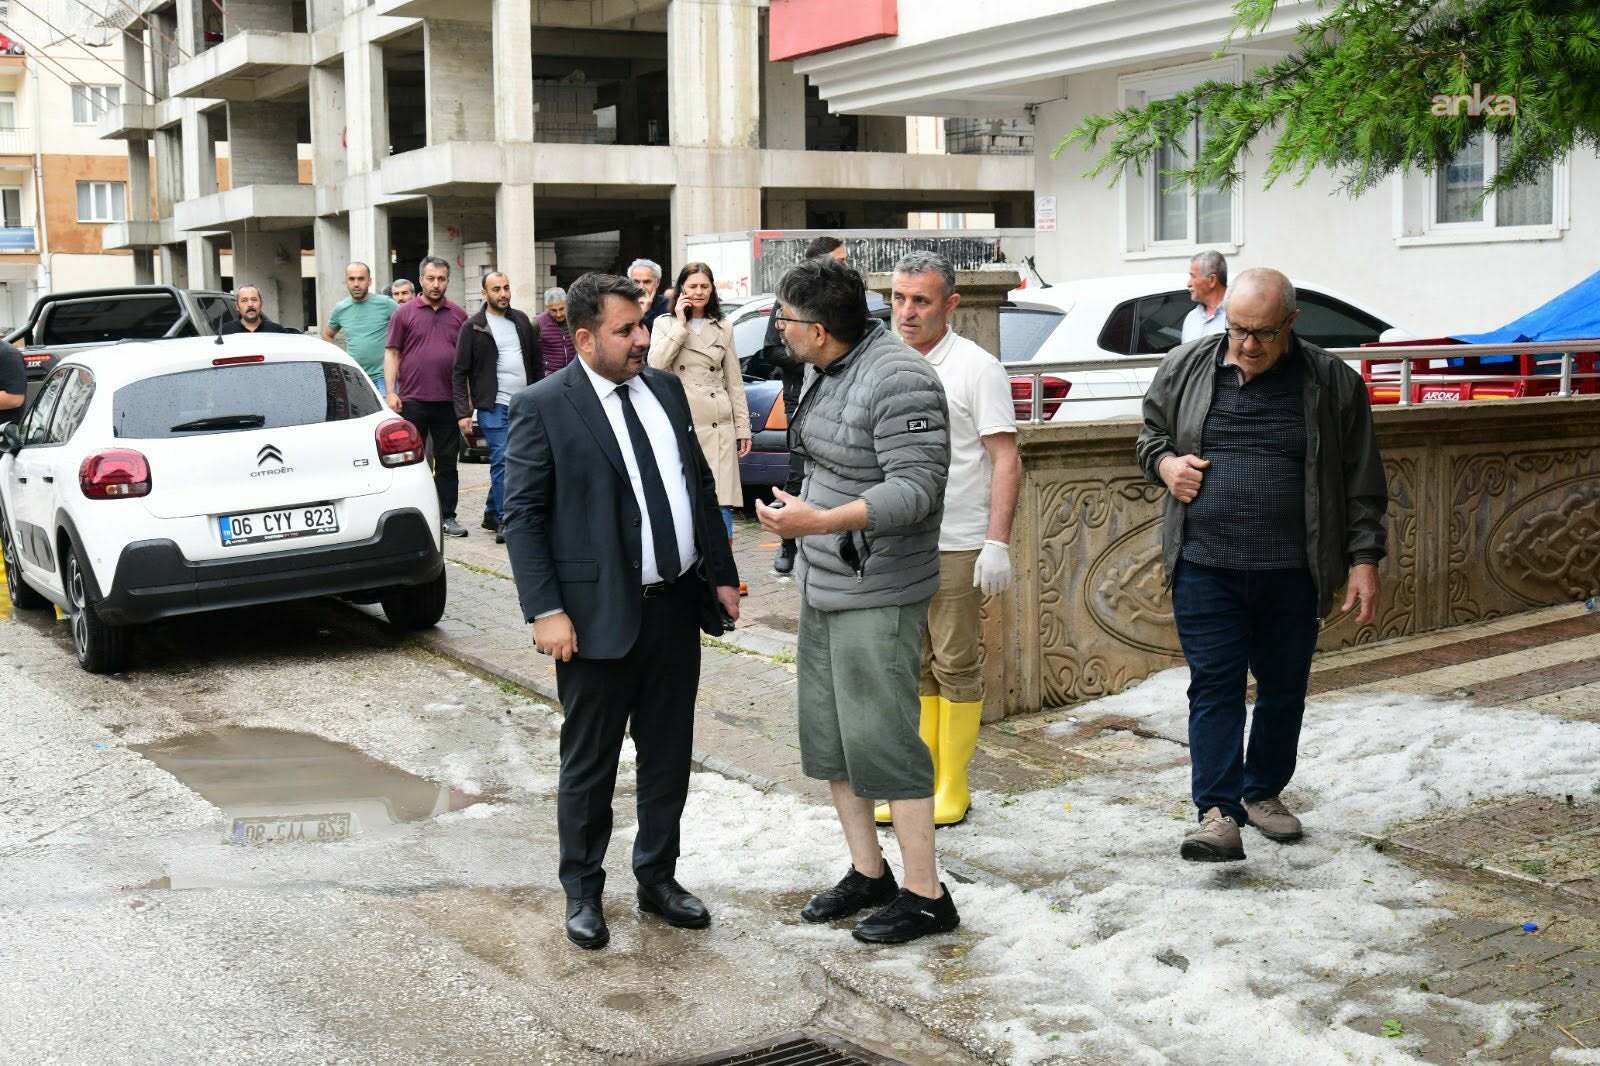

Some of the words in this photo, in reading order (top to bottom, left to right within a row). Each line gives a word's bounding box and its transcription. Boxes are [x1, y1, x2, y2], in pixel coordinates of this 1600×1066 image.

[1423, 391, 1460, 400] ARORA
[353, 458, 370, 468] C3
[250, 466, 294, 478] CITROËN
[232, 517, 252, 537] 06
[263, 511, 292, 533] CYY
[304, 508, 334, 528] 823
